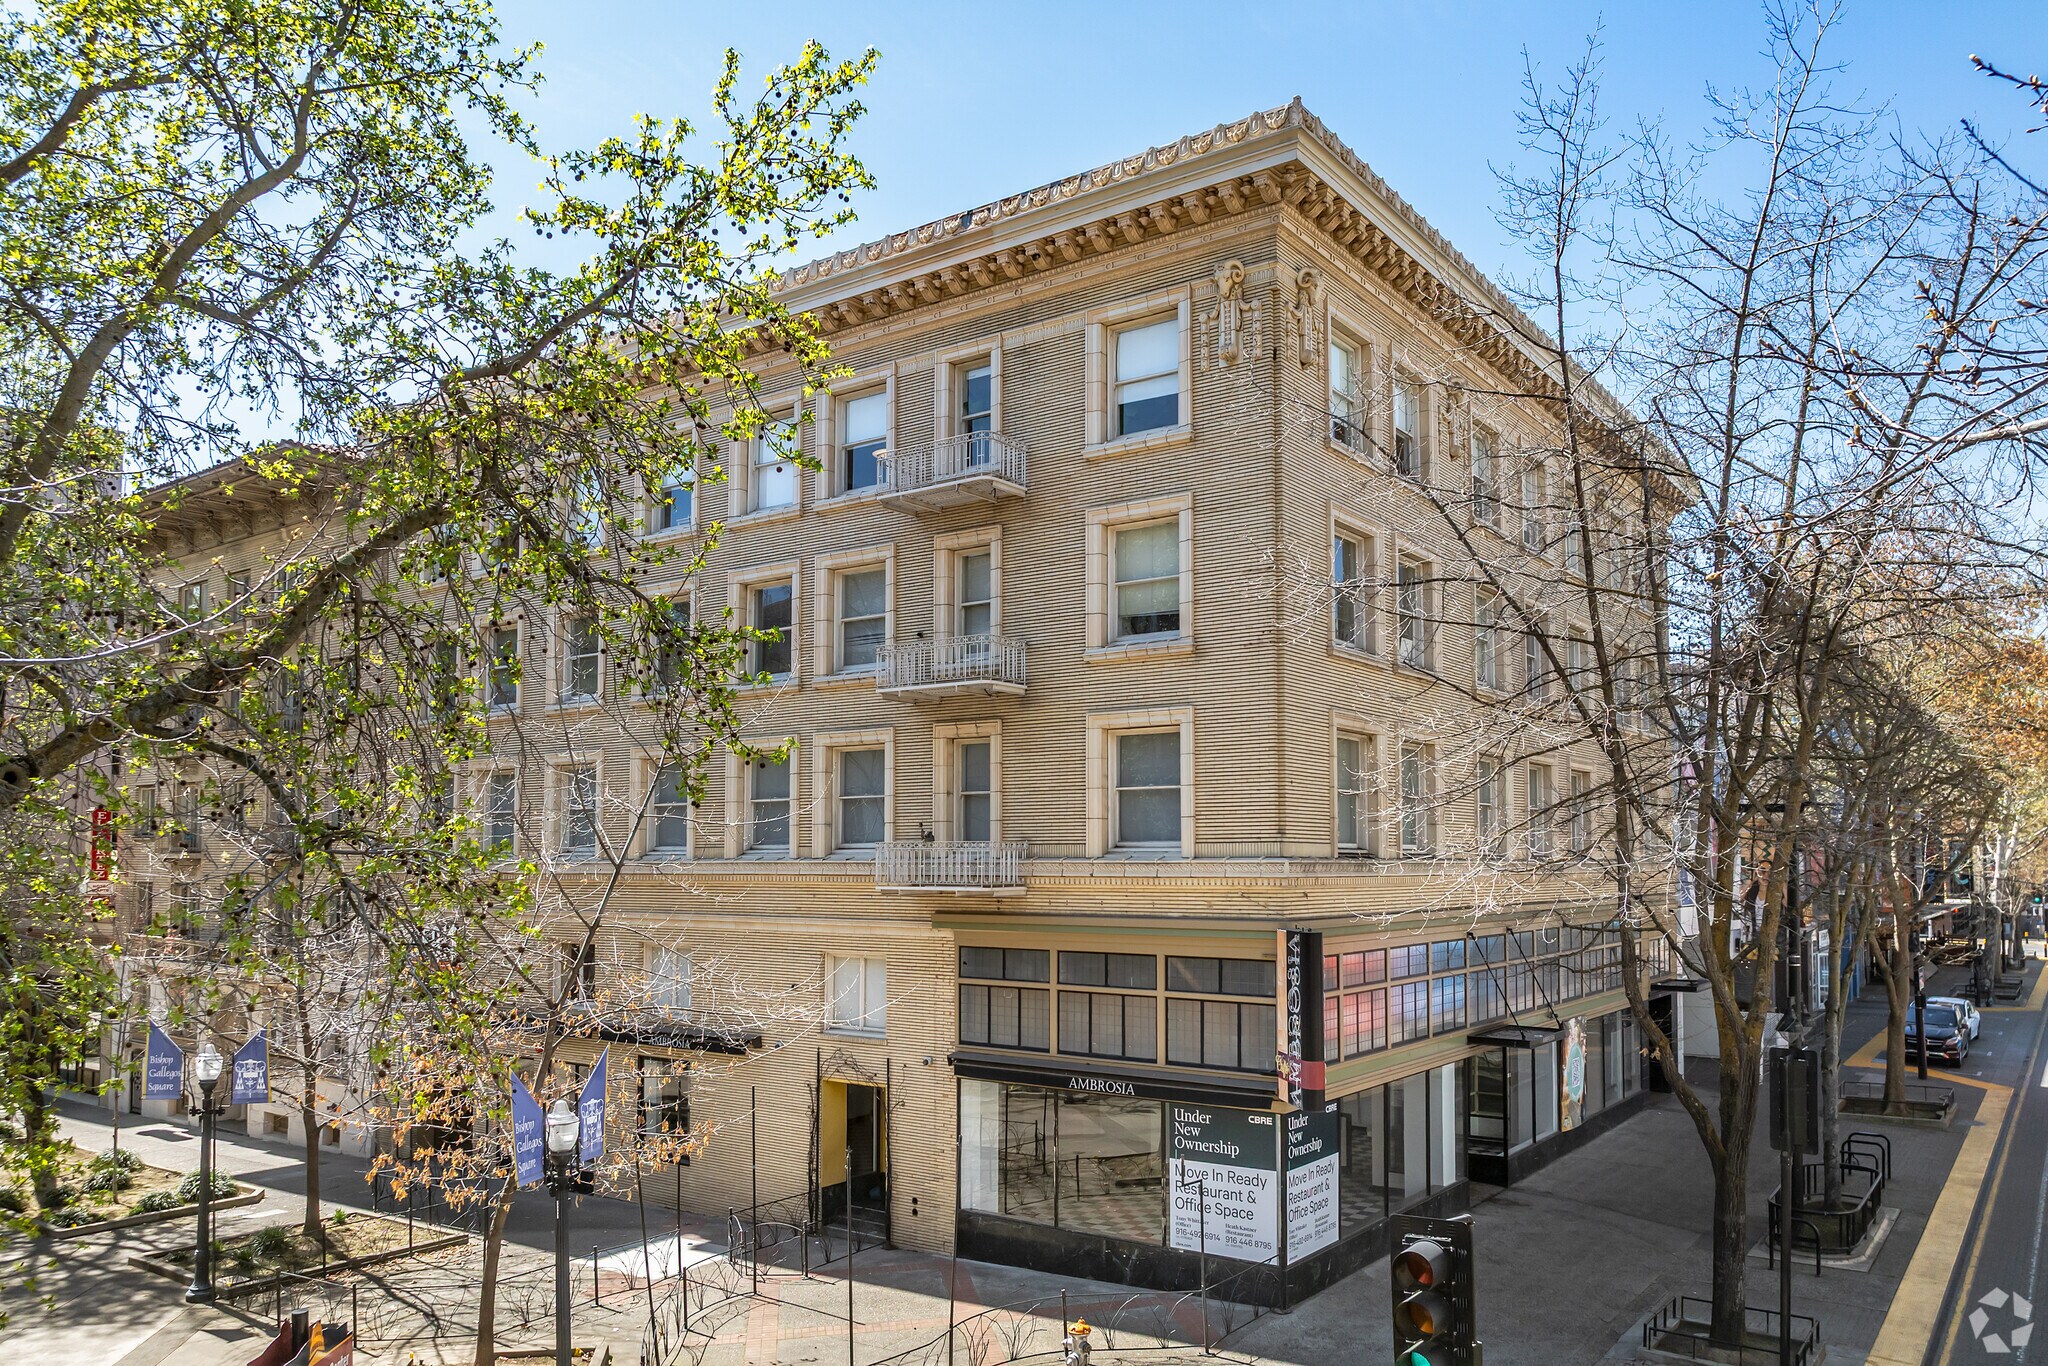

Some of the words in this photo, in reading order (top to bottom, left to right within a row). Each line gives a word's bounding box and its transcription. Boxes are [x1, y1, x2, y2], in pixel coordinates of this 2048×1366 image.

[149, 1053, 174, 1066] Bishop
[149, 1066, 182, 1080] Gallegos
[148, 1082, 174, 1093] Square
[1068, 1077, 1135, 1096] AMBROSIA
[1174, 1108, 1212, 1124] Under
[1325, 1102, 1338, 1113] CBRE
[515, 1115, 535, 1135] Bishop
[1174, 1122, 1201, 1137] New
[1248, 1115, 1273, 1126] CBRE
[1288, 1113, 1309, 1131] Under
[516, 1134, 543, 1154] Gallegos
[1174, 1136, 1240, 1159] Ownership
[1288, 1131, 1303, 1146] New
[1288, 1137, 1323, 1159] Ownership
[518, 1158, 537, 1175] Square
[1288, 1173, 1307, 1189] Move
[1308, 1168, 1315, 1181] In
[1316, 1160, 1335, 1179] Ready
[1175, 1164, 1209, 1180] Move
[1212, 1168, 1223, 1182] In
[1227, 1170, 1268, 1191] Ready
[1175, 1180, 1243, 1203] Restaurant
[1247, 1190, 1257, 1204] &
[1288, 1182, 1324, 1206] Restaurant
[1324, 1177, 1330, 1191] &
[1175, 1197, 1211, 1214] Office
[1215, 1202, 1254, 1221] Space
[1288, 1206, 1308, 1223] Office
[1309, 1197, 1329, 1215] Space
[1175, 1227, 1221, 1241] 916-4926914
[1225, 1235, 1238, 1244] 916
[1239, 1237, 1253, 1247] 446
[1254, 1240, 1272, 1250] 8795
